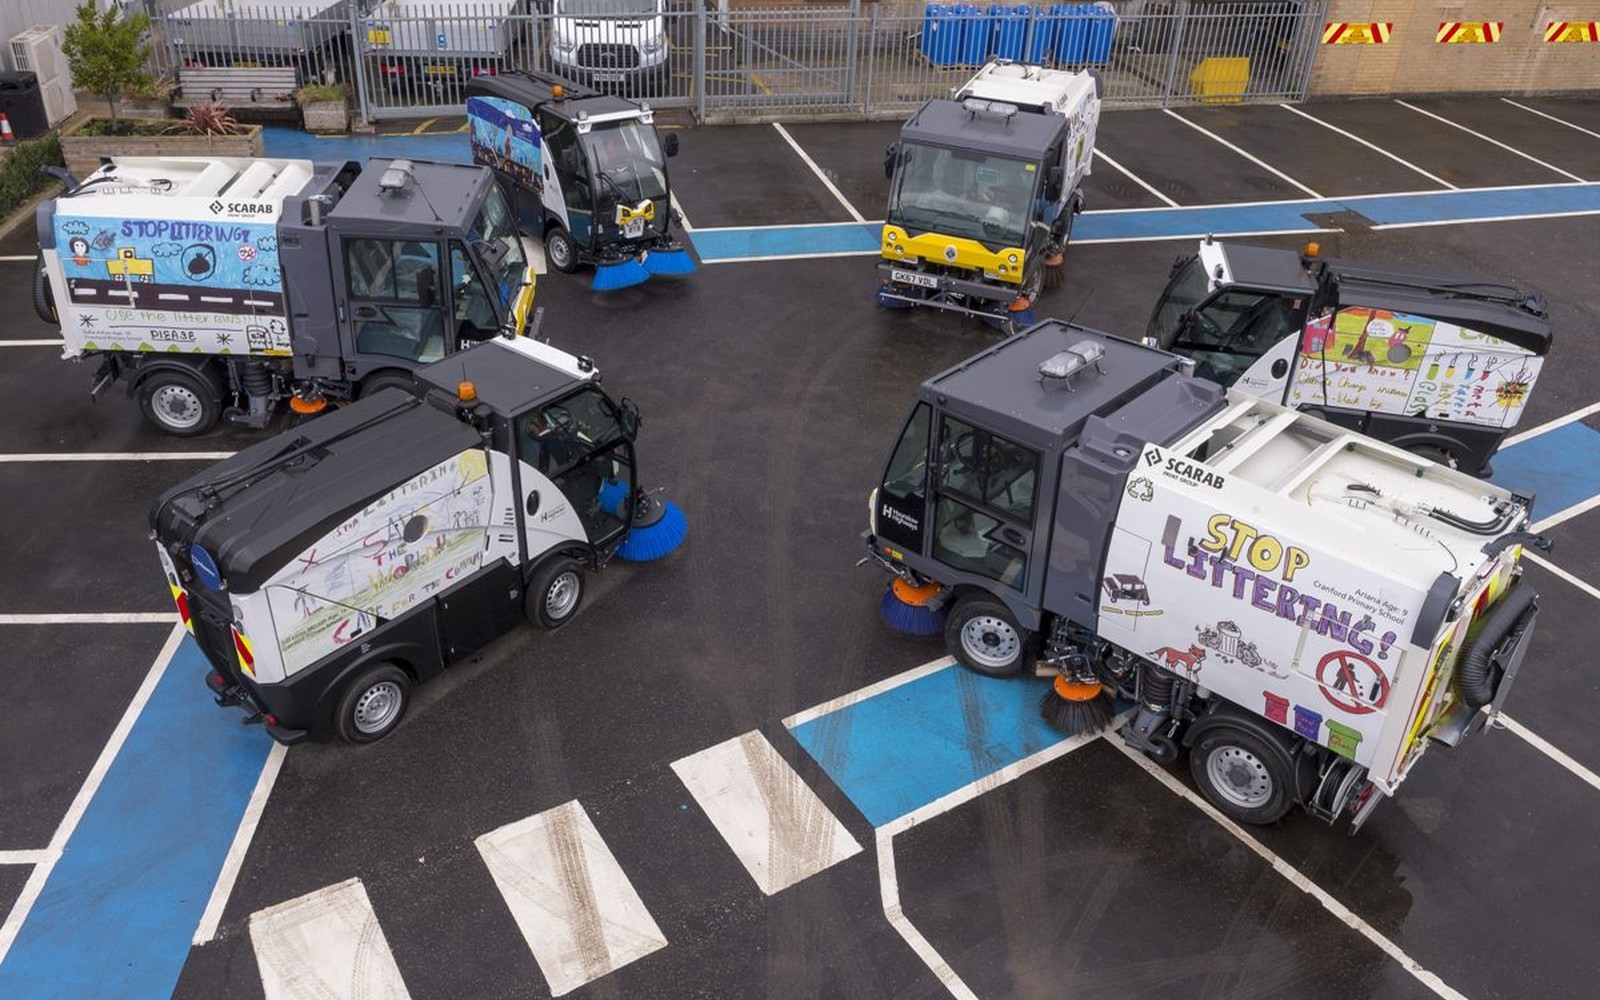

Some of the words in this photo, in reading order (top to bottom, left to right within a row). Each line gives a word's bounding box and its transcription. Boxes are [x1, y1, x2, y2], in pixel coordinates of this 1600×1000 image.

[227, 203, 273, 213] SCARAB
[121, 220, 168, 240] STOP
[141, 310, 166, 322] the
[174, 311, 209, 323] litter
[1165, 457, 1225, 490] SCARAB
[1201, 513, 1311, 582] STOP
[1163, 542, 1397, 661] LITTERING!
[1313, 580, 1347, 600] Cranford
[1347, 596, 1378, 614] Primary
[1378, 608, 1405, 625] School
[1354, 588, 1381, 605] Ariana
